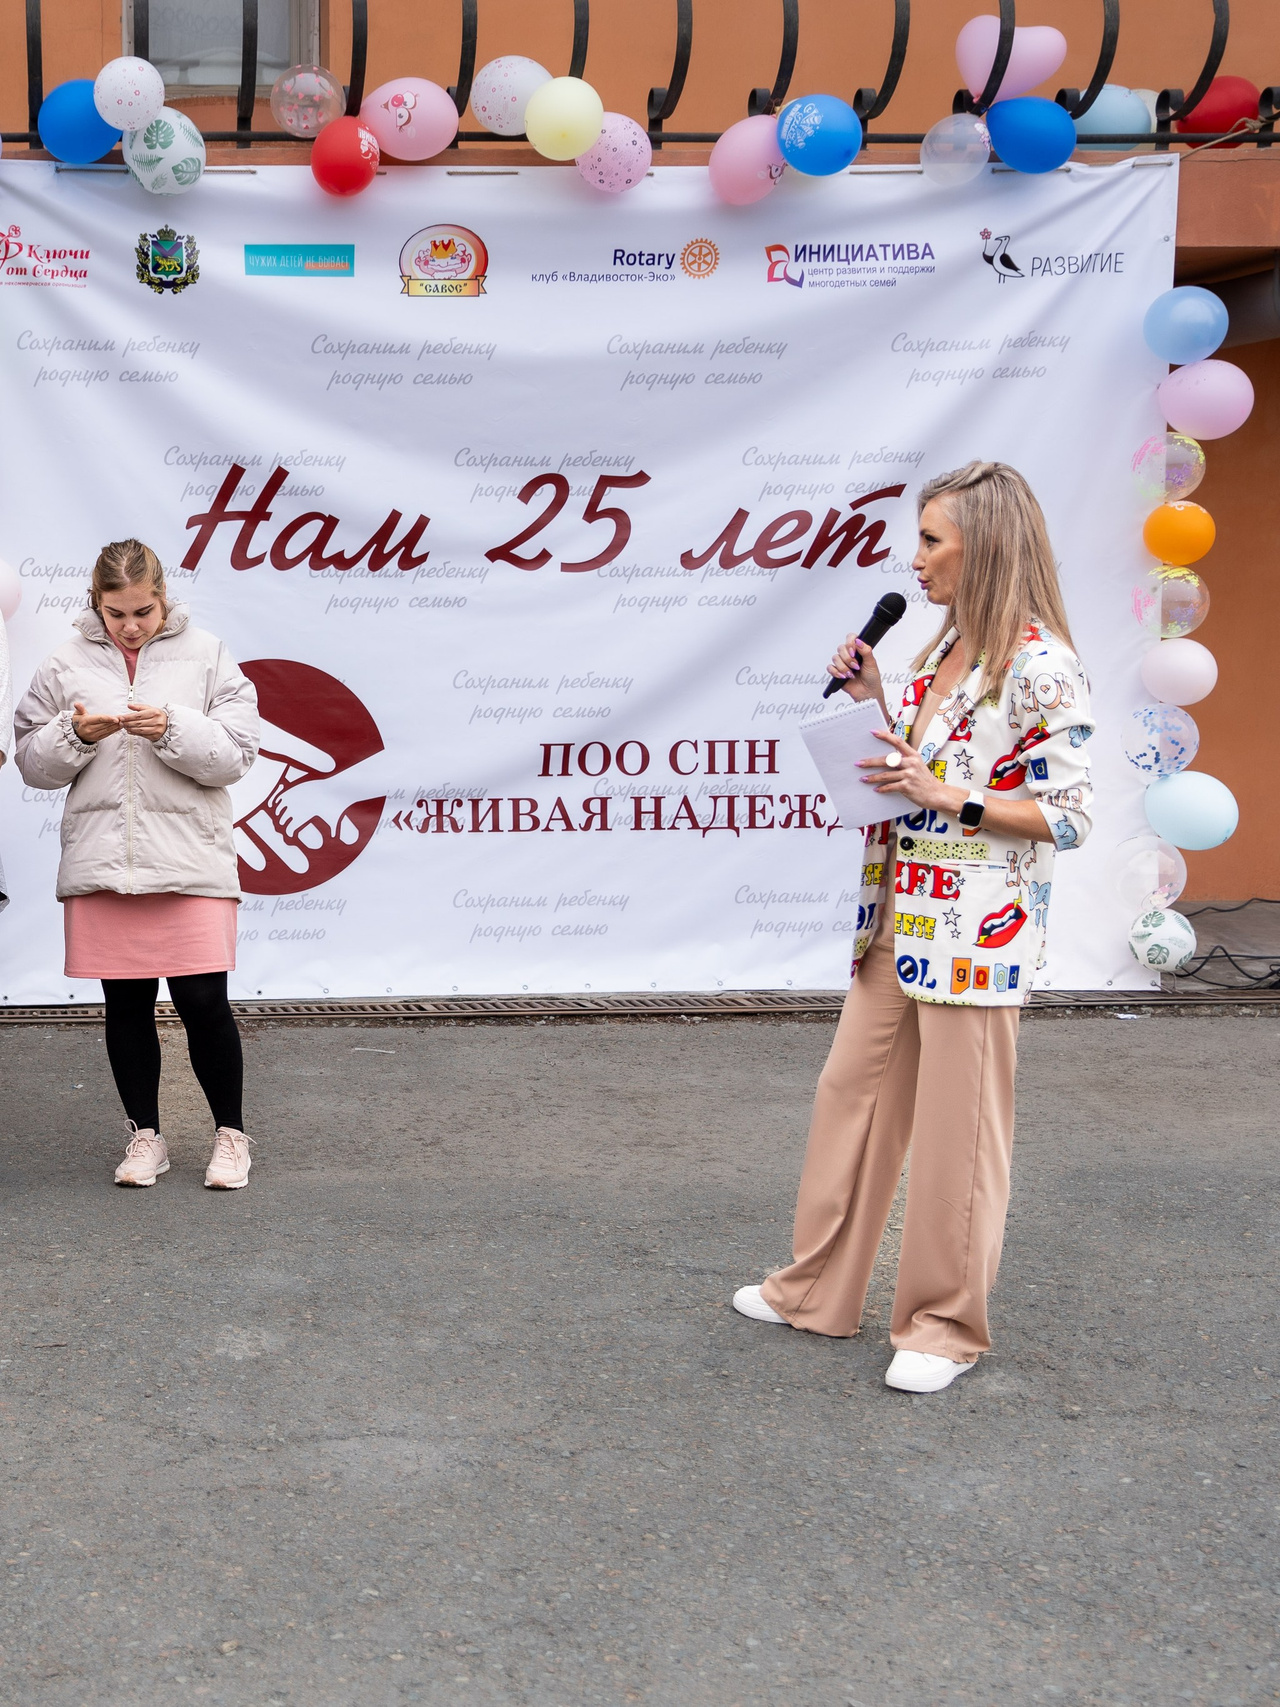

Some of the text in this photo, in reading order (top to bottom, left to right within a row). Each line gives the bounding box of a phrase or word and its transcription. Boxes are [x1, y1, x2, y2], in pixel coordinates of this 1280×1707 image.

[27, 244, 91, 263] Ключи
[249, 253, 350, 268] ЧУЖИХ ДЕТЕЙ НЕ БЫВАЕТ
[613, 249, 676, 269] Rotary
[794, 243, 936, 265] ИНИЦИАТИВА
[1031, 253, 1125, 277] РАЗВИТИЕ
[6, 264, 89, 280] от Сердца
[531, 271, 676, 284] клуб «Владивосток-Эко»
[807, 267, 834, 276] центр
[836, 266, 877, 276] развития
[887, 265, 936, 275] поддержки
[808, 277, 897, 289] многодетных семей
[17, 330, 200, 359] Сохраним ребенку
[311, 334, 497, 360] Сохраним ребенку
[606, 334, 788, 360] Сохраним ребенку
[891, 330, 1071, 358] Сохраним ребенку
[33, 366, 178, 387] родную семью
[326, 370, 473, 391] родную семью
[620, 370, 763, 391] родную семью
[906, 365, 1047, 388] родную семью
[163, 445, 347, 473] Сохраним ребенку
[454, 447, 636, 473] Сохраним ребенку
[741, 445, 925, 471] Сохраним ребенку
[758, 482, 835, 502] родную
[180, 463, 908, 573] Нам 25 лет
[412, 561, 490, 585] ребенку
[325, 594, 467, 614] родную семью
[613, 593, 757, 613] родную семью
[453, 669, 634, 695] Сохраним ребенку
[736, 666, 832, 692] Сохраним
[469, 704, 611, 725] родную семью
[751, 700, 826, 721] родную
[538, 739, 781, 777] ПОО СПН
[593, 777, 771, 802] Сохраним ребенку
[391, 796, 613, 834] «ЖИВАЯ
[271, 893, 347, 917] ребенку
[453, 888, 630, 914] Сохраним ребенку
[735, 884, 829, 909] Сохраним
[268, 928, 326, 941] семью
[469, 923, 609, 943] родную семью
[750, 919, 824, 939] родную
[952, 961, 1019, 989] good
